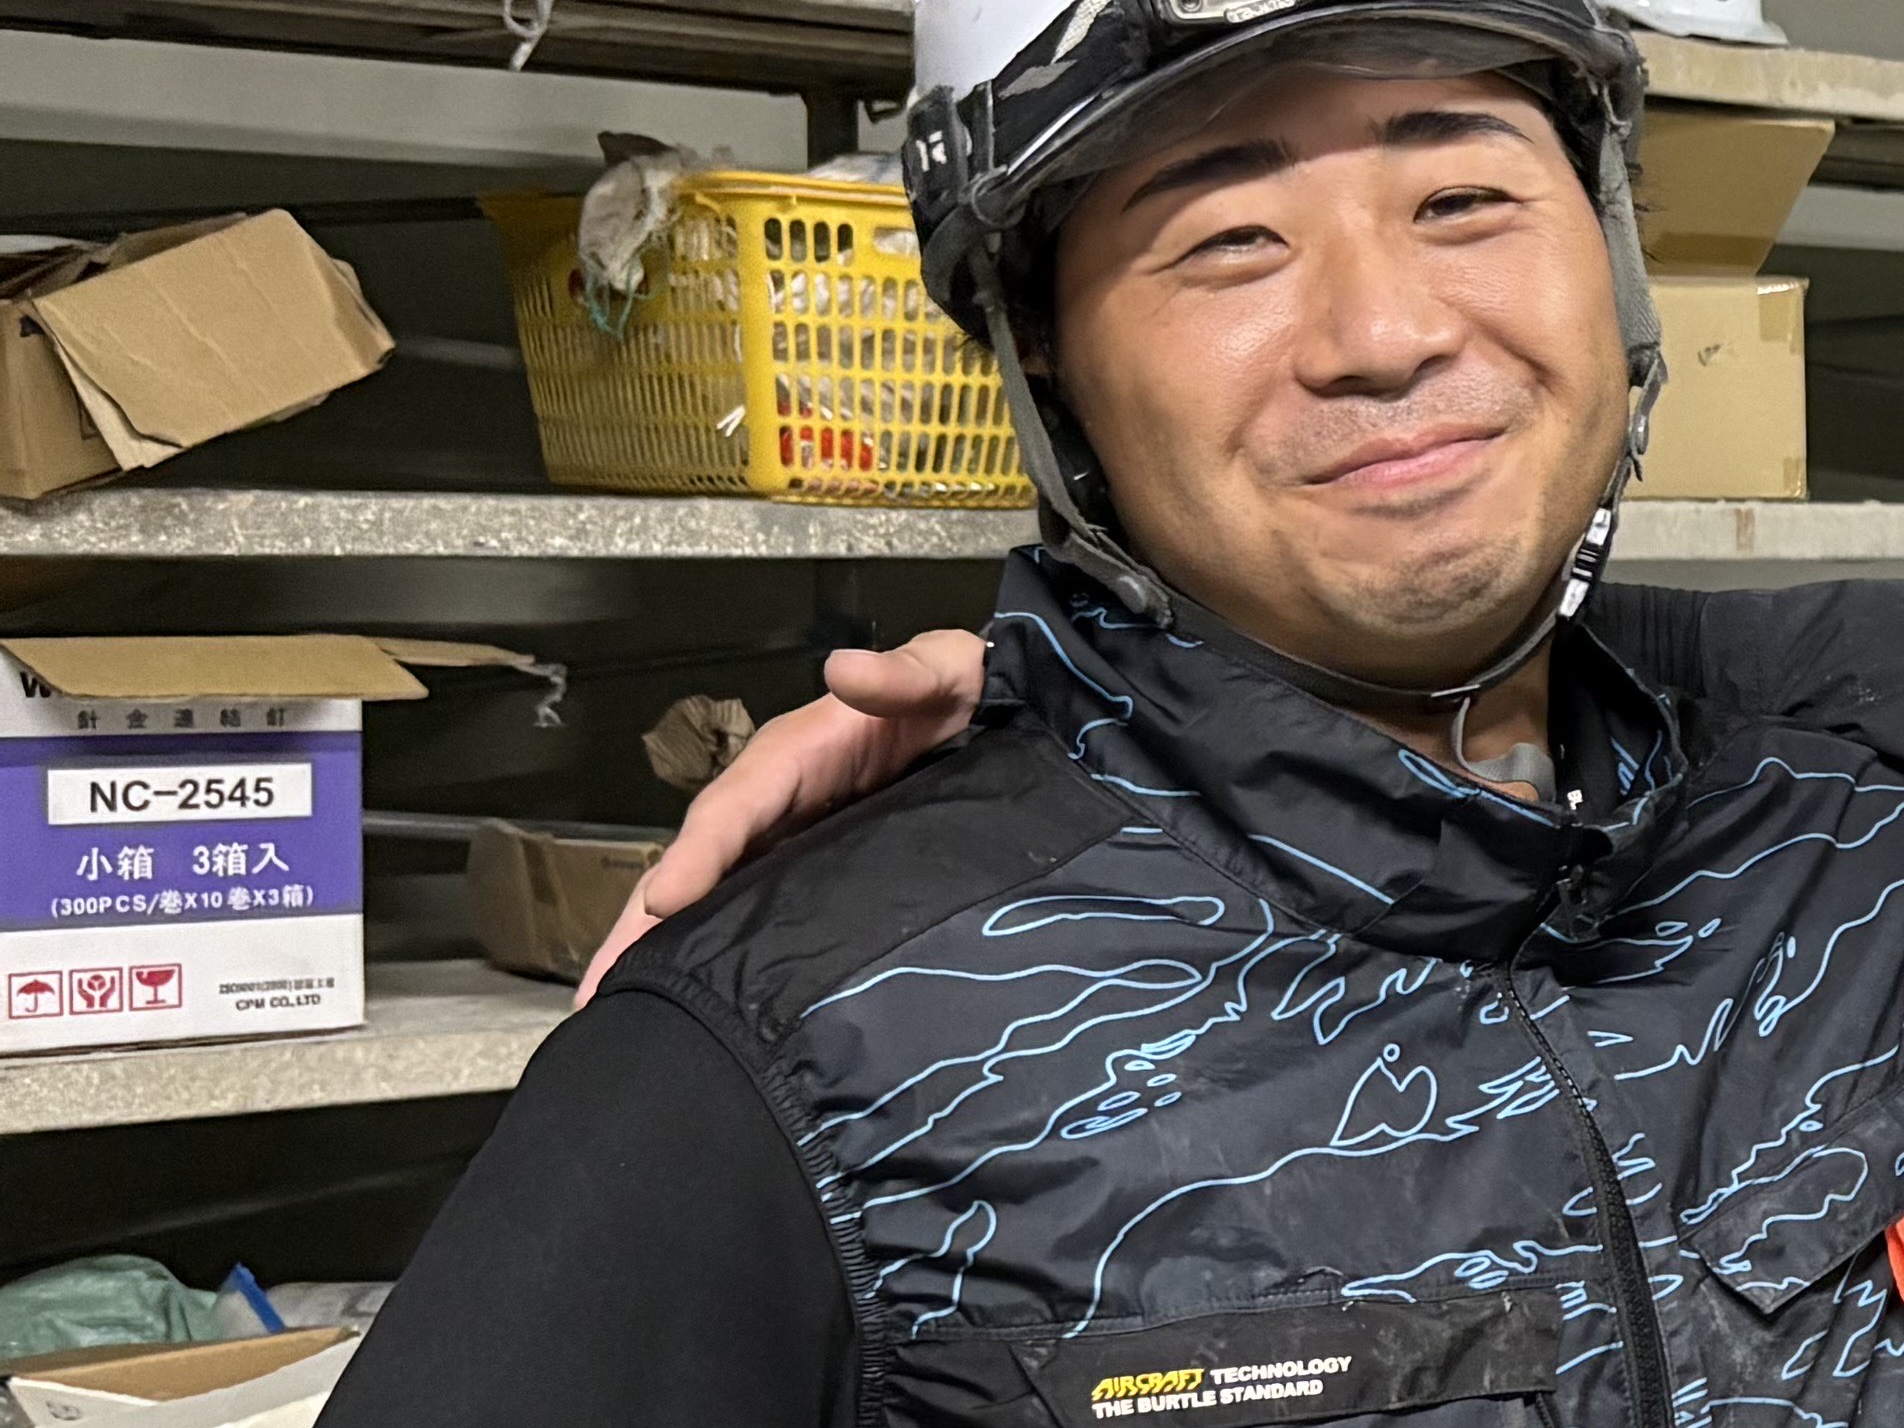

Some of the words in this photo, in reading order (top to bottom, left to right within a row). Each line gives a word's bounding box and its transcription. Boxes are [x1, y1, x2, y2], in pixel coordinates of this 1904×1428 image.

[90, 777, 275, 813] NC-2545
[76, 845, 154, 881] 小箱
[193, 842, 290, 877] 3箱入
[1091, 1368, 1204, 1401] AIRCRAFT
[1210, 1356, 1352, 1385] TECHNOLOGY
[1092, 1401, 1134, 1419] THE
[1137, 1391, 1217, 1414] BURTLE
[1220, 1380, 1323, 1406] STANDARD
